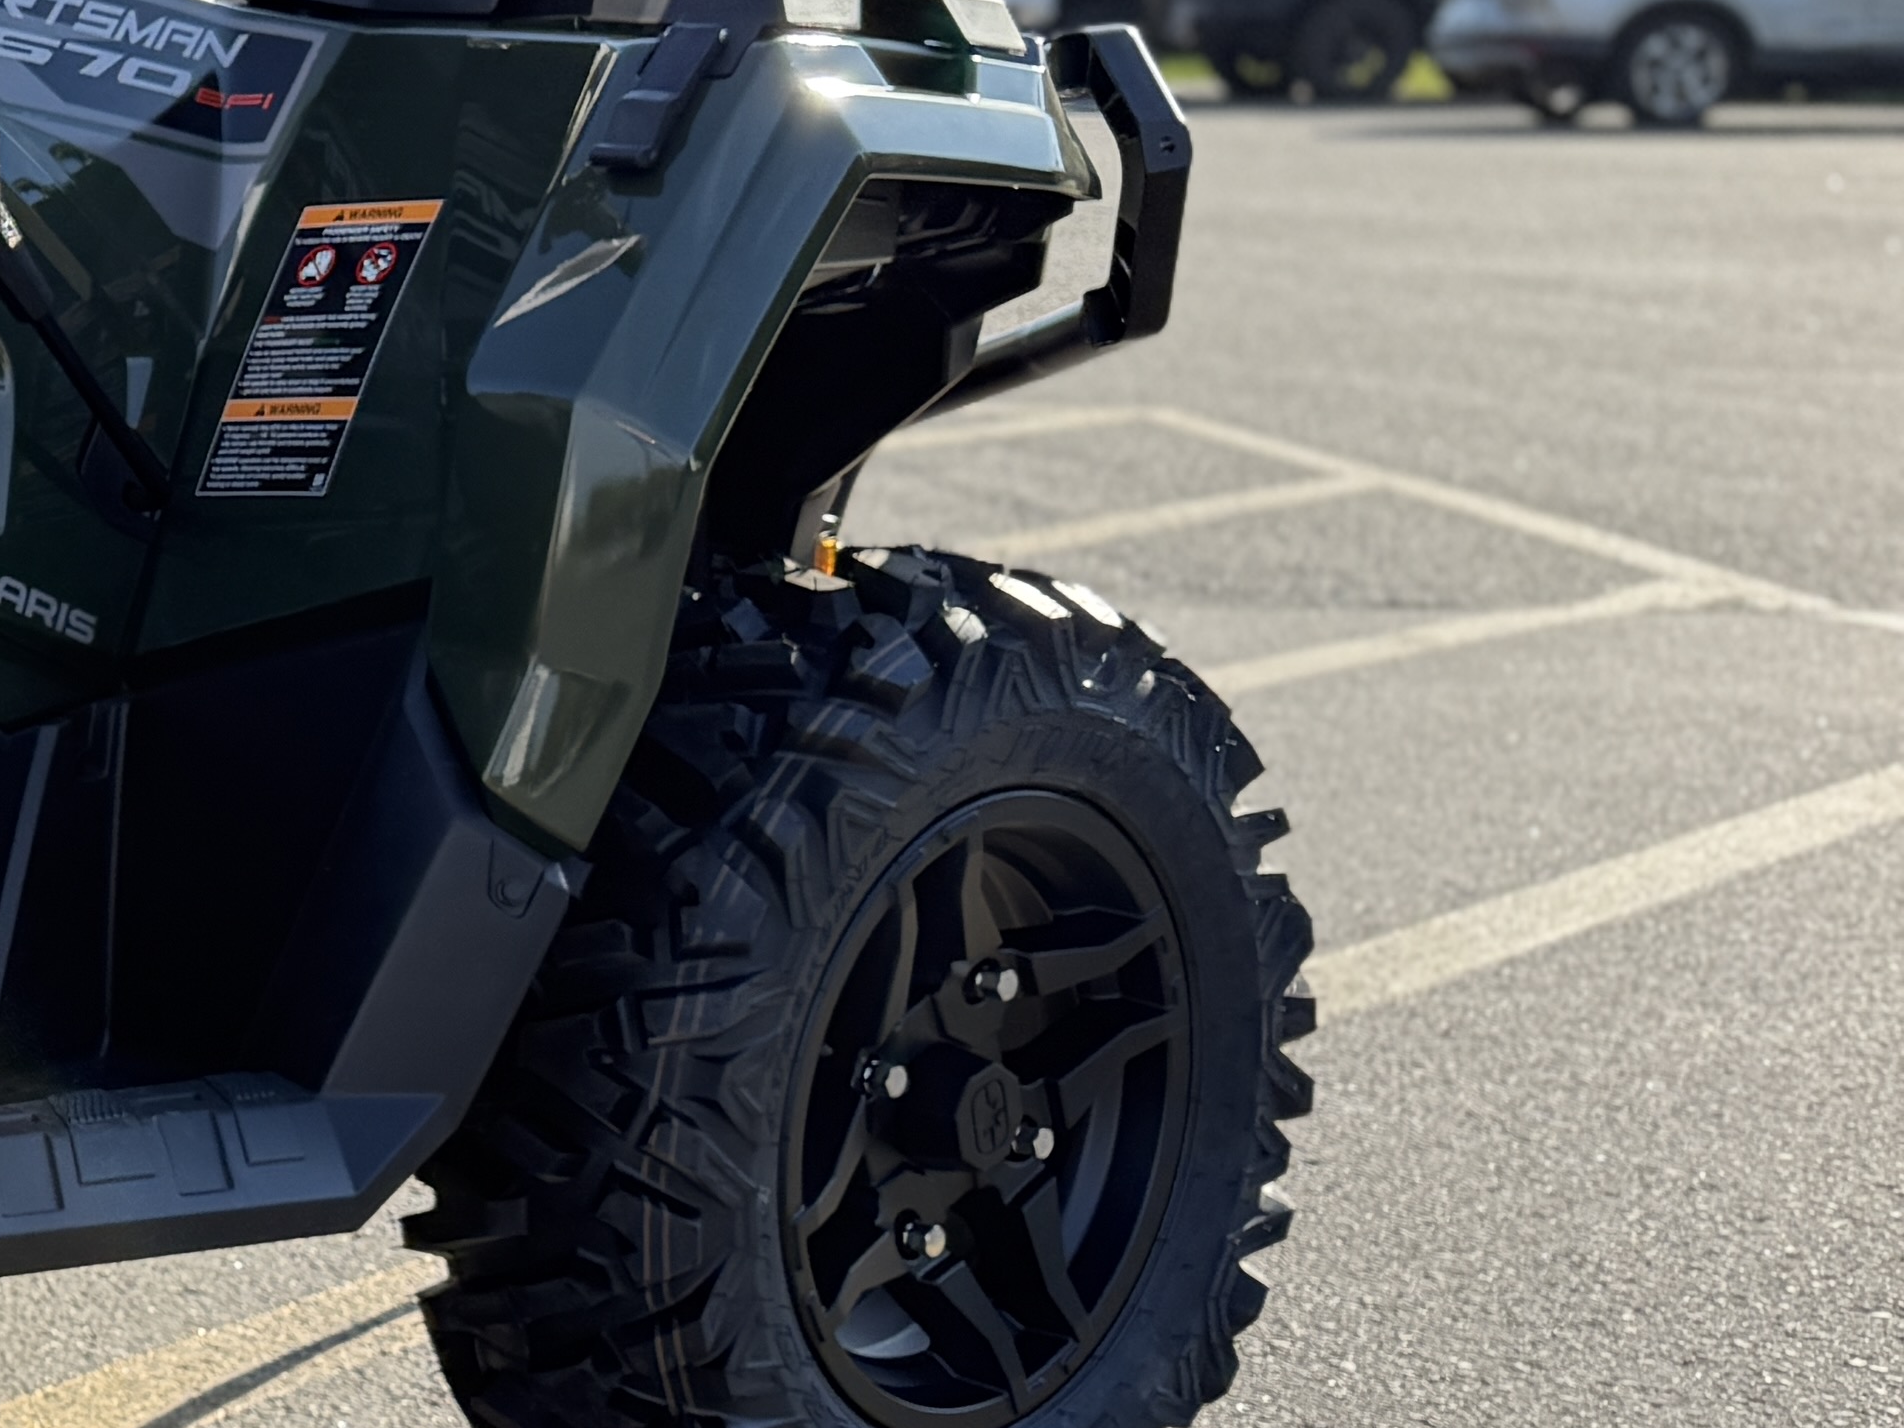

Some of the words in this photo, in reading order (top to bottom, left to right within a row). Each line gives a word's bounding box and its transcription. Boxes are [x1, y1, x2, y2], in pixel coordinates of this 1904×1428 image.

[195, 87, 274, 111] EFI
[349, 207, 403, 219] WARNING
[270, 403, 321, 415] WARNING
